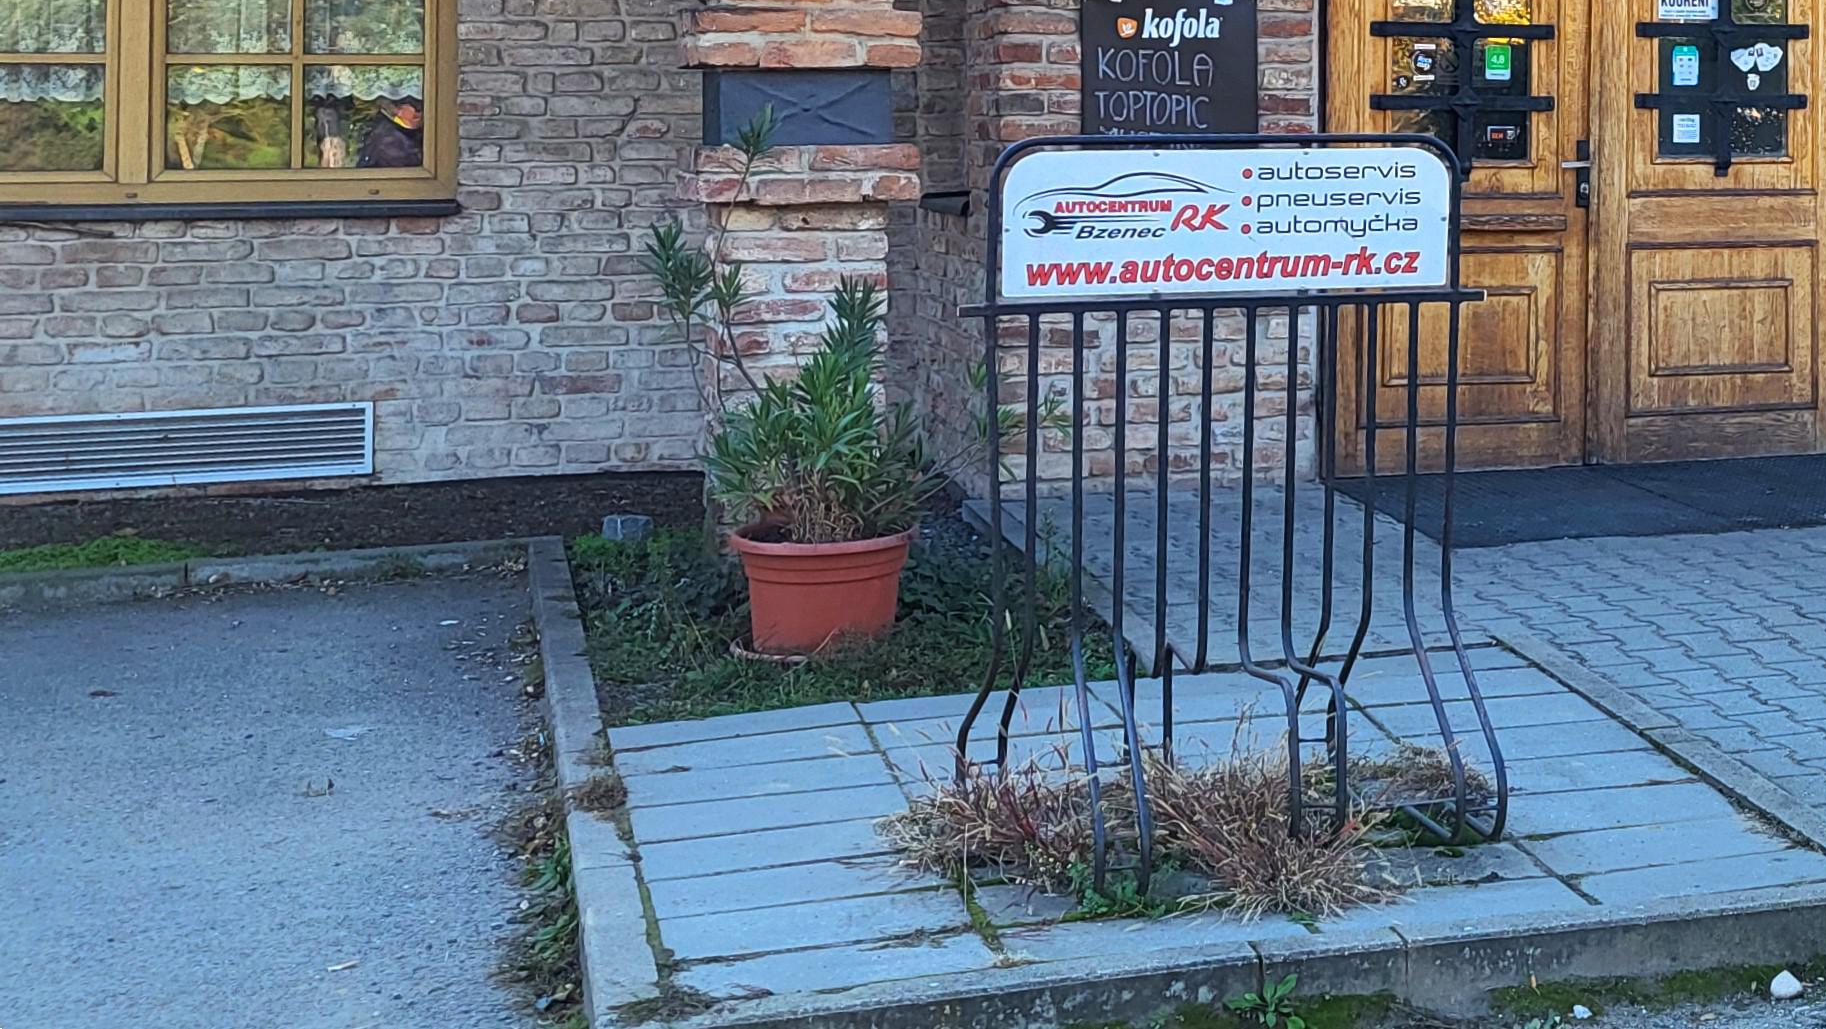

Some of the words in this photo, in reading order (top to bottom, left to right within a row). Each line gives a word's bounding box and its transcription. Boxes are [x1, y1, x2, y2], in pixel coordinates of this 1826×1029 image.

[1141, 8, 1221, 47] kofola
[1098, 47, 1213, 87] KOFOLA
[1257, 161, 1416, 180] autoservis
[1256, 188, 1421, 213] pneuservis
[1054, 200, 1173, 214] AUTOCENTRUM
[1170, 204, 1230, 232] RK
[1256, 213, 1418, 238] automyčka
[1075, 225, 1167, 240] Bzenec
[1026, 246, 1421, 286] www.autocentrum-rk.cz
